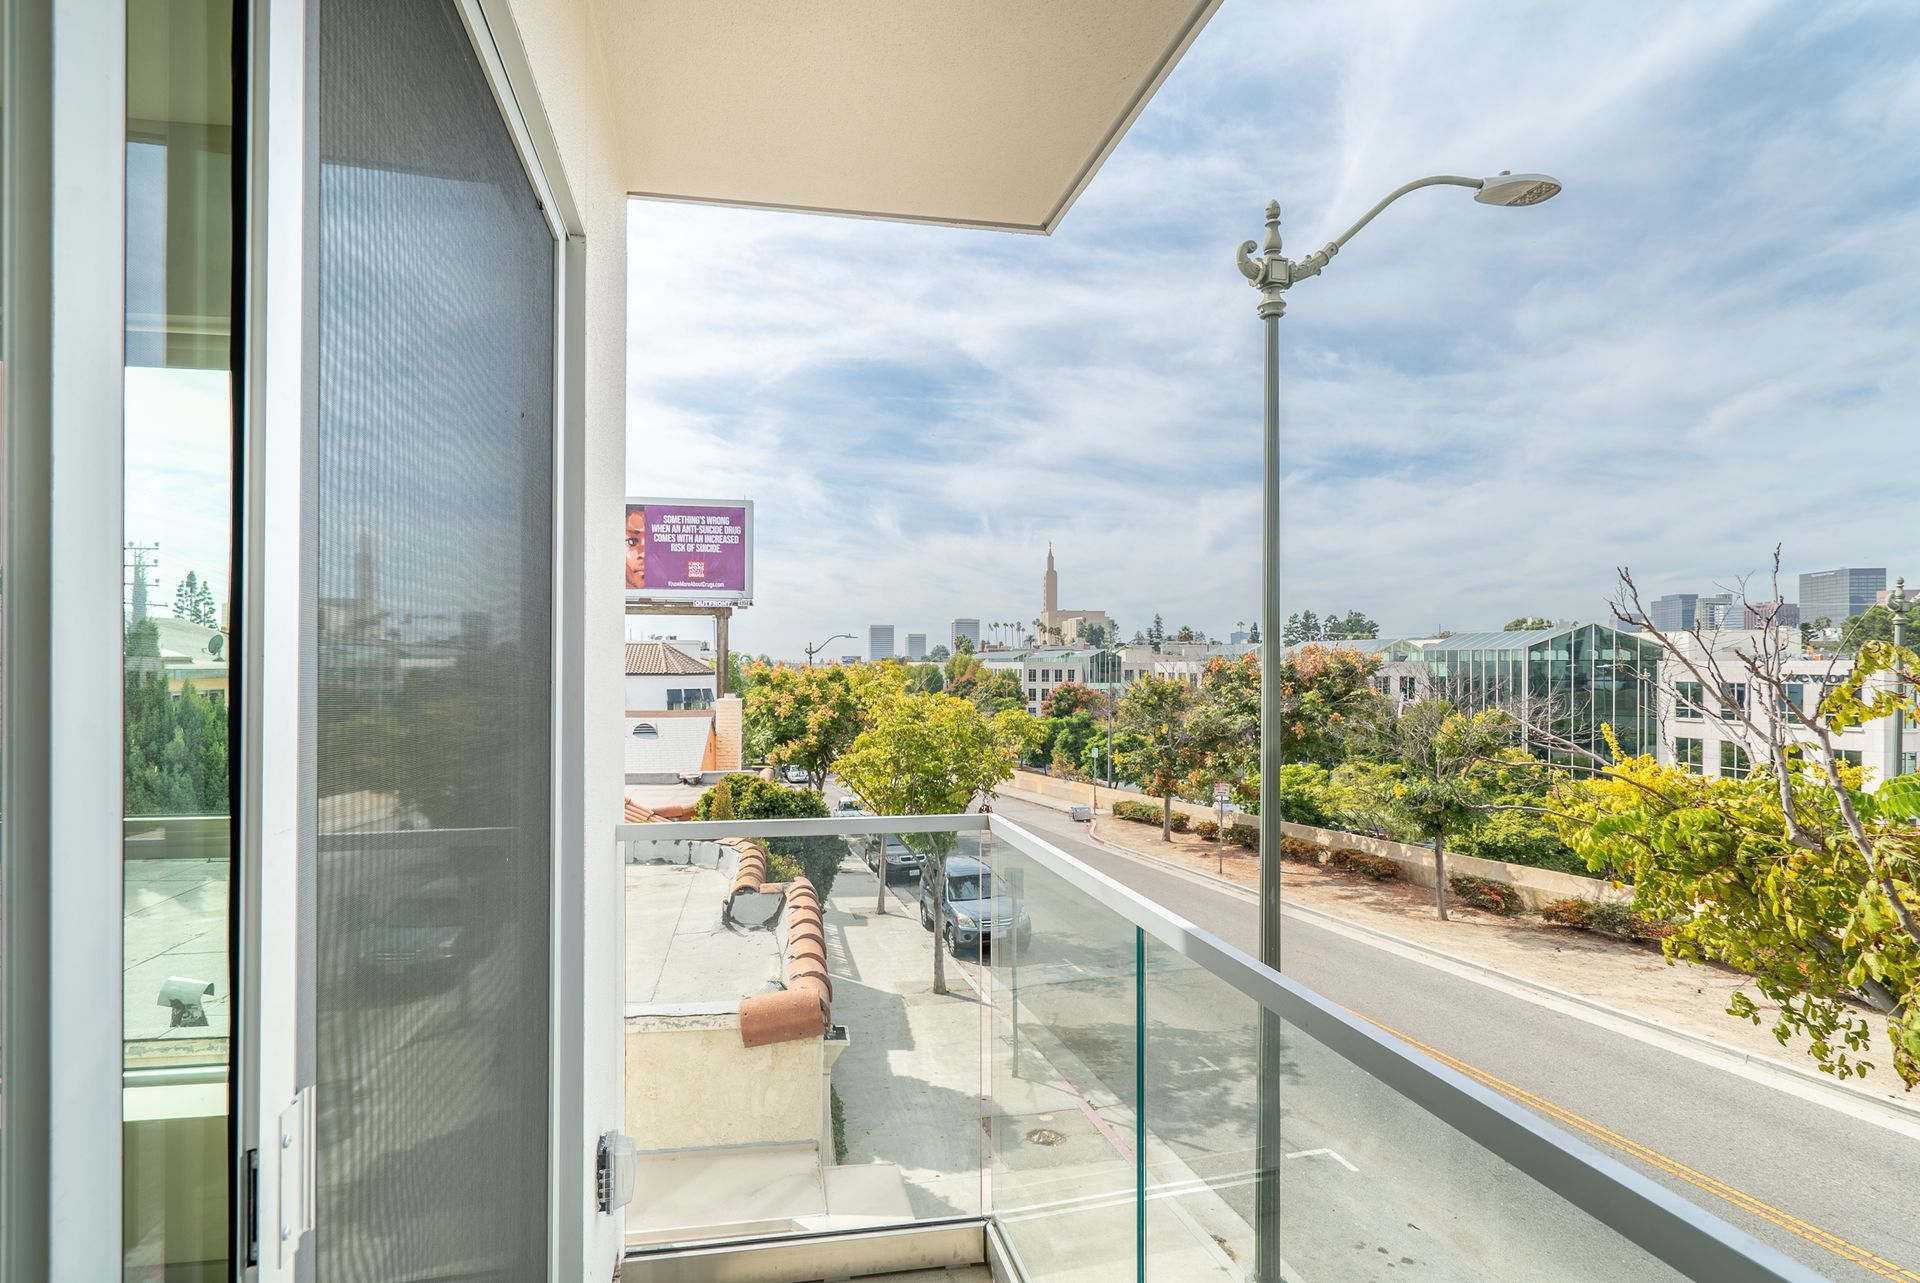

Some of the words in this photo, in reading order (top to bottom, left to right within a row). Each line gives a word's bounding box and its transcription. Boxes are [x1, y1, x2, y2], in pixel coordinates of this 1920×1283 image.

[663, 515, 705, 525] SOMETHING'S
[706, 516, 730, 525] WRONG
[651, 524, 671, 533] WHEN
[671, 525, 681, 533] AN
[681, 525, 723, 534] ANTI-SUICIDE
[724, 526, 741, 535] DRUG
[653, 534, 676, 542] COMES
[677, 534, 694, 543] WITH
[694, 535, 704, 543] AN
[704, 535, 739, 544] INCREASED
[670, 543, 686, 552] RISK
[686, 544, 695, 552] OF
[695, 544, 722, 553] SUICIDE.
